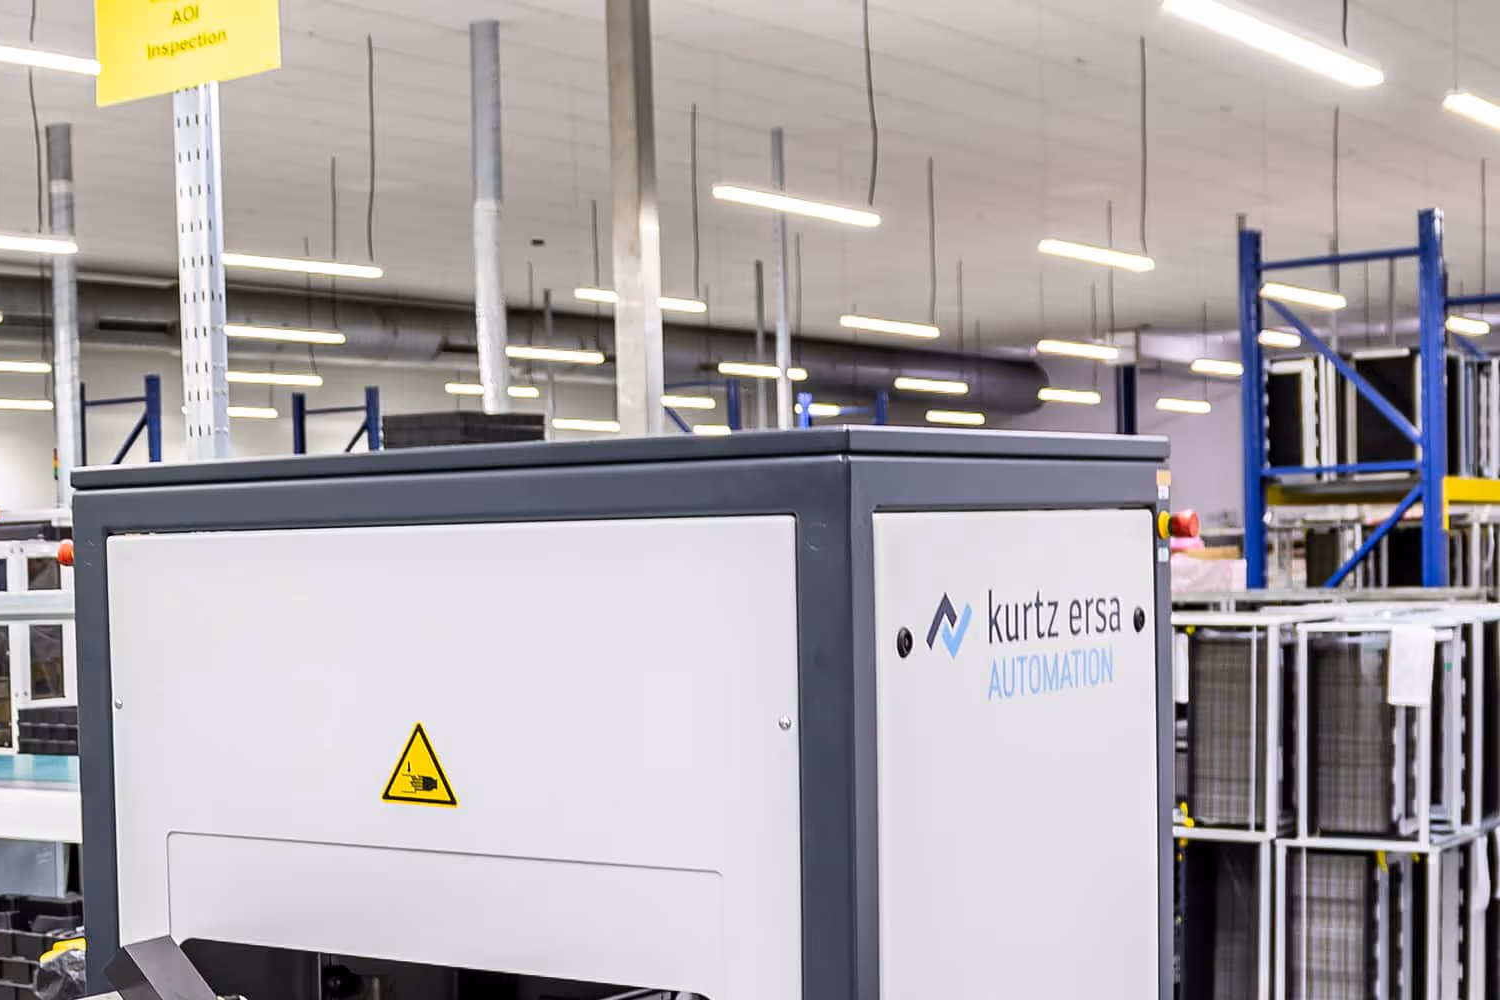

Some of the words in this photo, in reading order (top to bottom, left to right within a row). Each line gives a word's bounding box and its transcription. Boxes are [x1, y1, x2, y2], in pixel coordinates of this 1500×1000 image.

[171, 5, 200, 25] AOI
[147, 29, 228, 59] Inspection
[987, 588, 1059, 644] kurtz
[1068, 596, 1121, 636] ersa
[987, 646, 1114, 701] AUTOMATION
